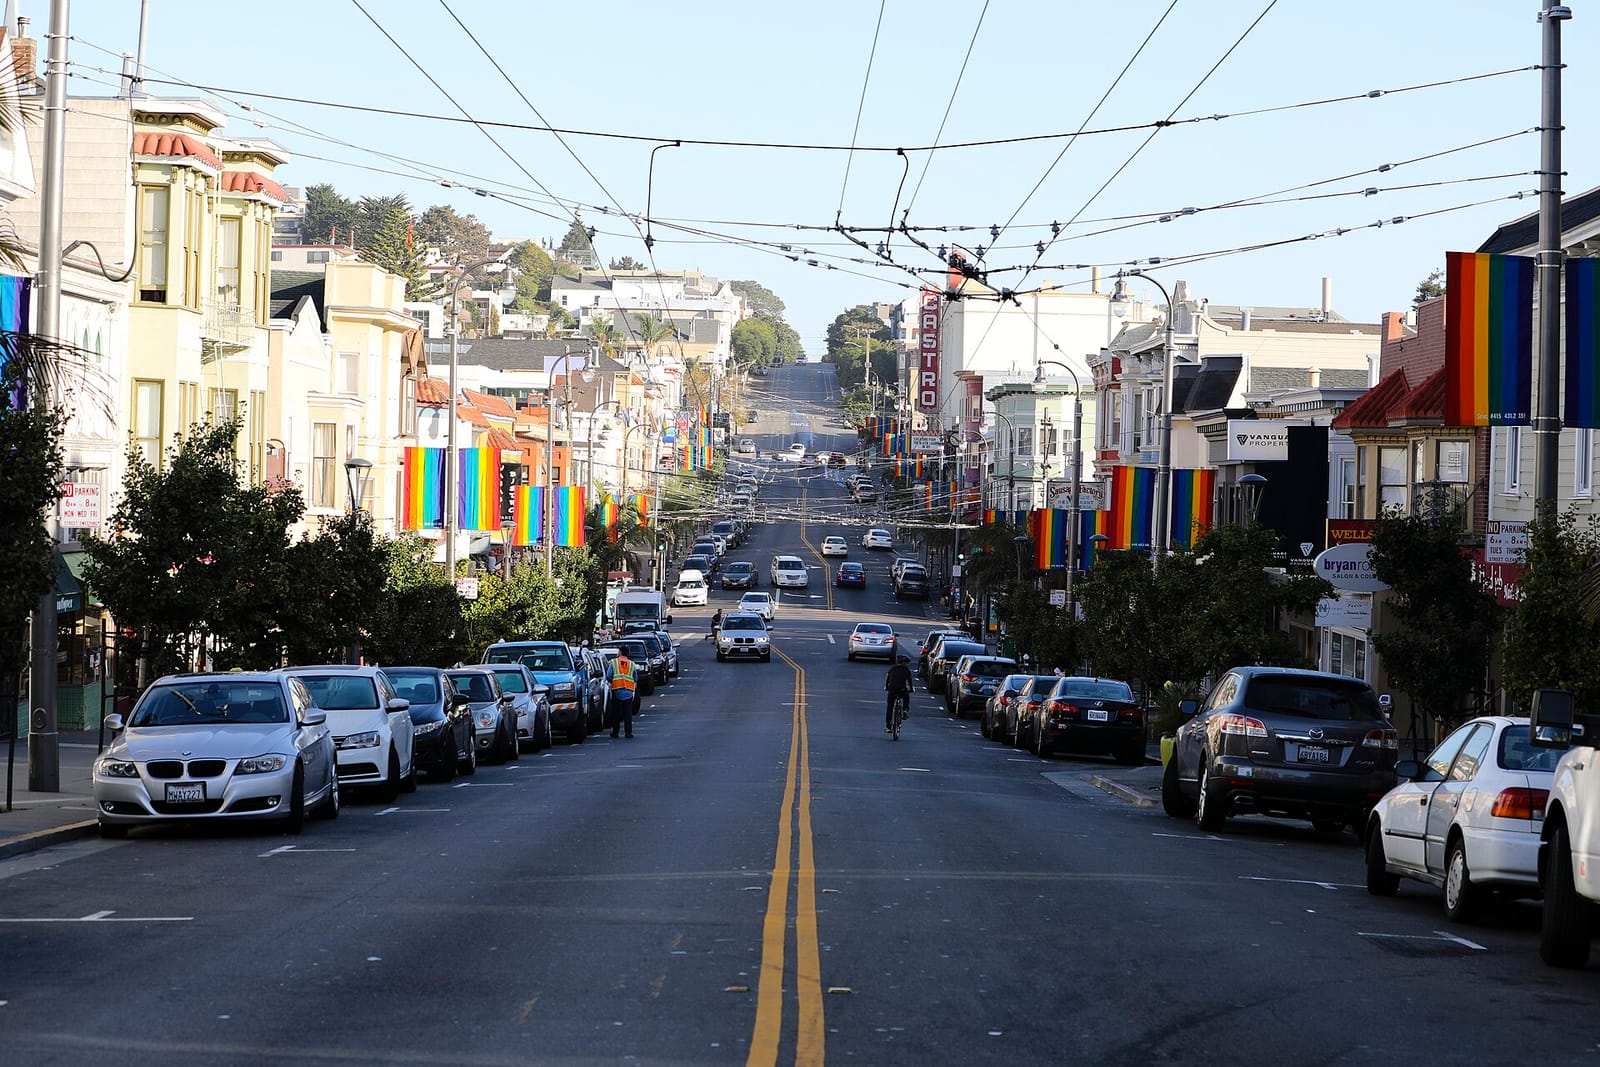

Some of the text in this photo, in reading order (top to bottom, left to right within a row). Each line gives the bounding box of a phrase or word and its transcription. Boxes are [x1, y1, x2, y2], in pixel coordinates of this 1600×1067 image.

[922, 295, 938, 406] CASTRO
[75, 487, 99, 496] PARKING
[1488, 522, 1499, 533] NO
[1330, 529, 1374, 540] WELLS
